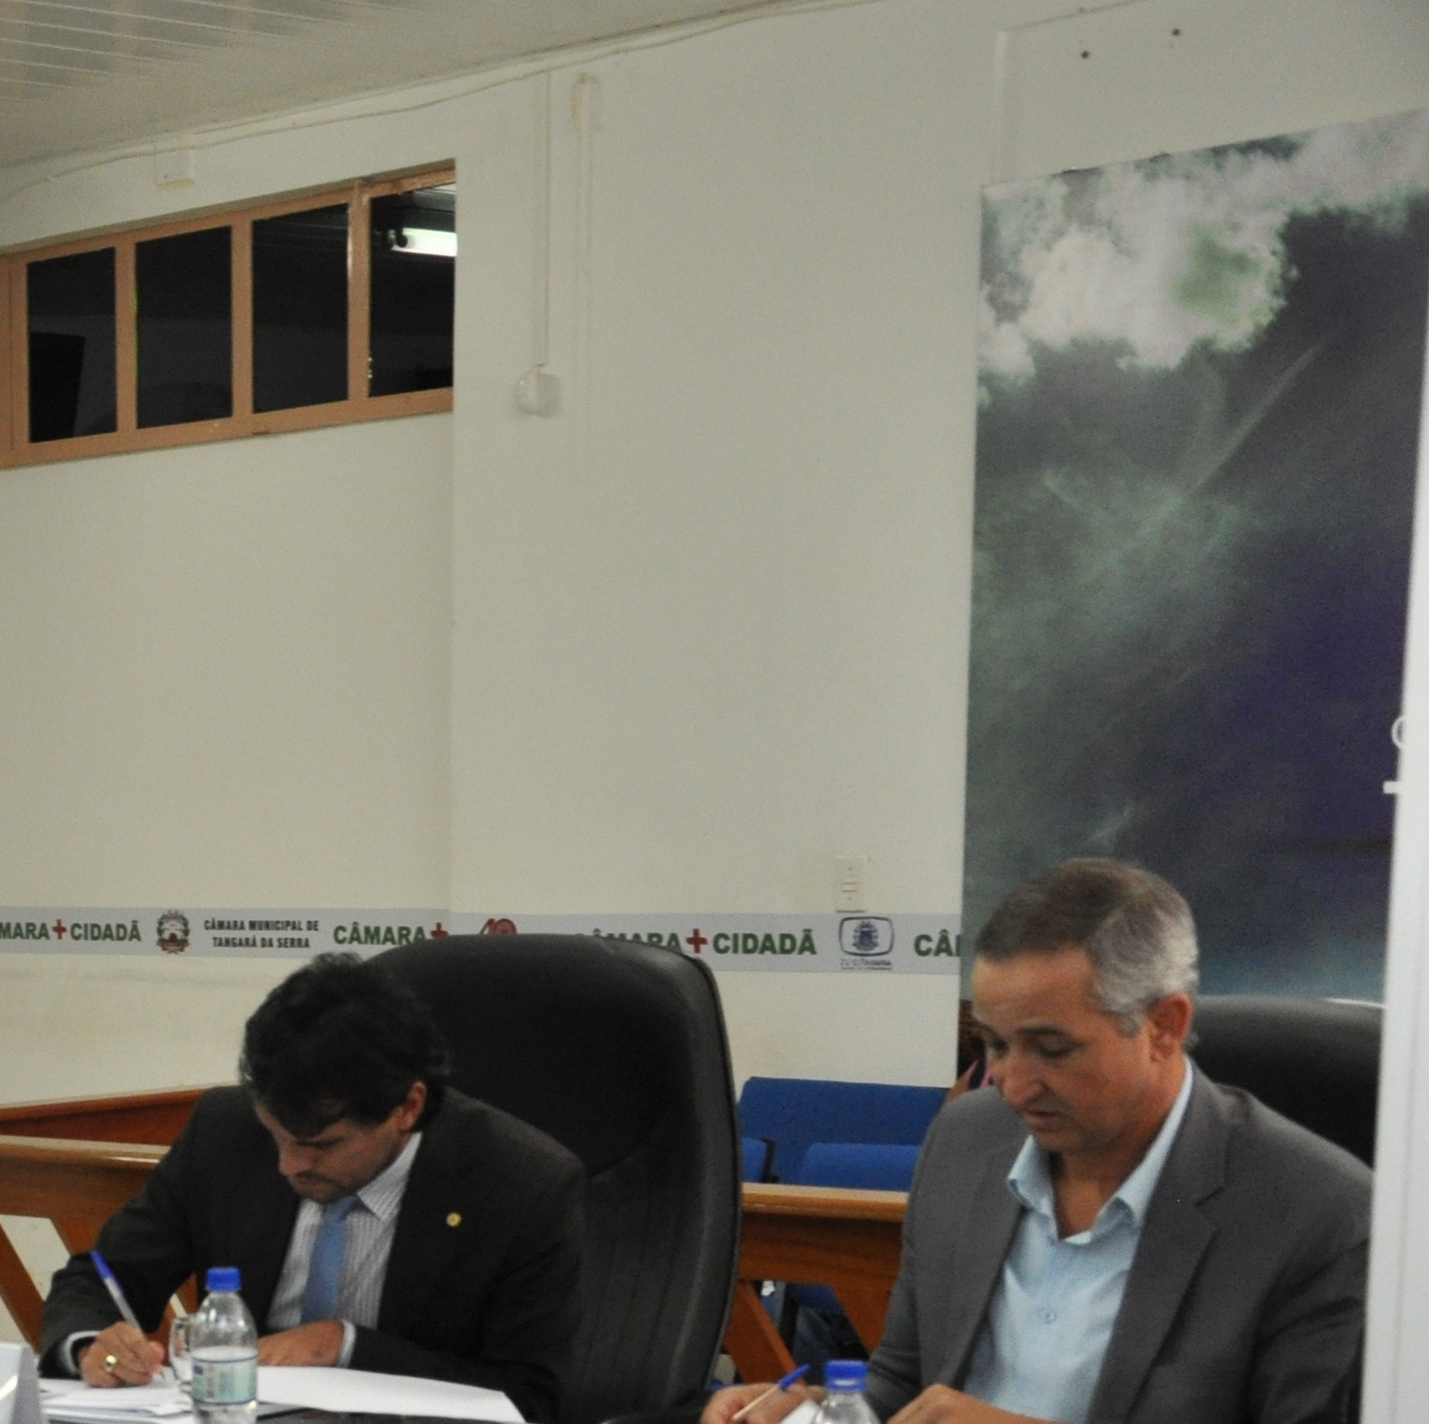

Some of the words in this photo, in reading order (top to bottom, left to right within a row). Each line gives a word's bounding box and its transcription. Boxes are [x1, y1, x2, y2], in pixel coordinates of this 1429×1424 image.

[70, 917, 142, 942] CIDADÃ
[203, 918, 245, 931] CÂMARA
[249, 920, 302, 931] MUNICIPAL
[306, 920, 319, 931] DE
[333, 921, 428, 945] CÂMARA
[213, 935, 257, 948] TANGARÁ
[261, 937, 273, 948] DA
[277, 937, 310, 949] SERRA
[712, 929, 818, 956] CIDADÃ
